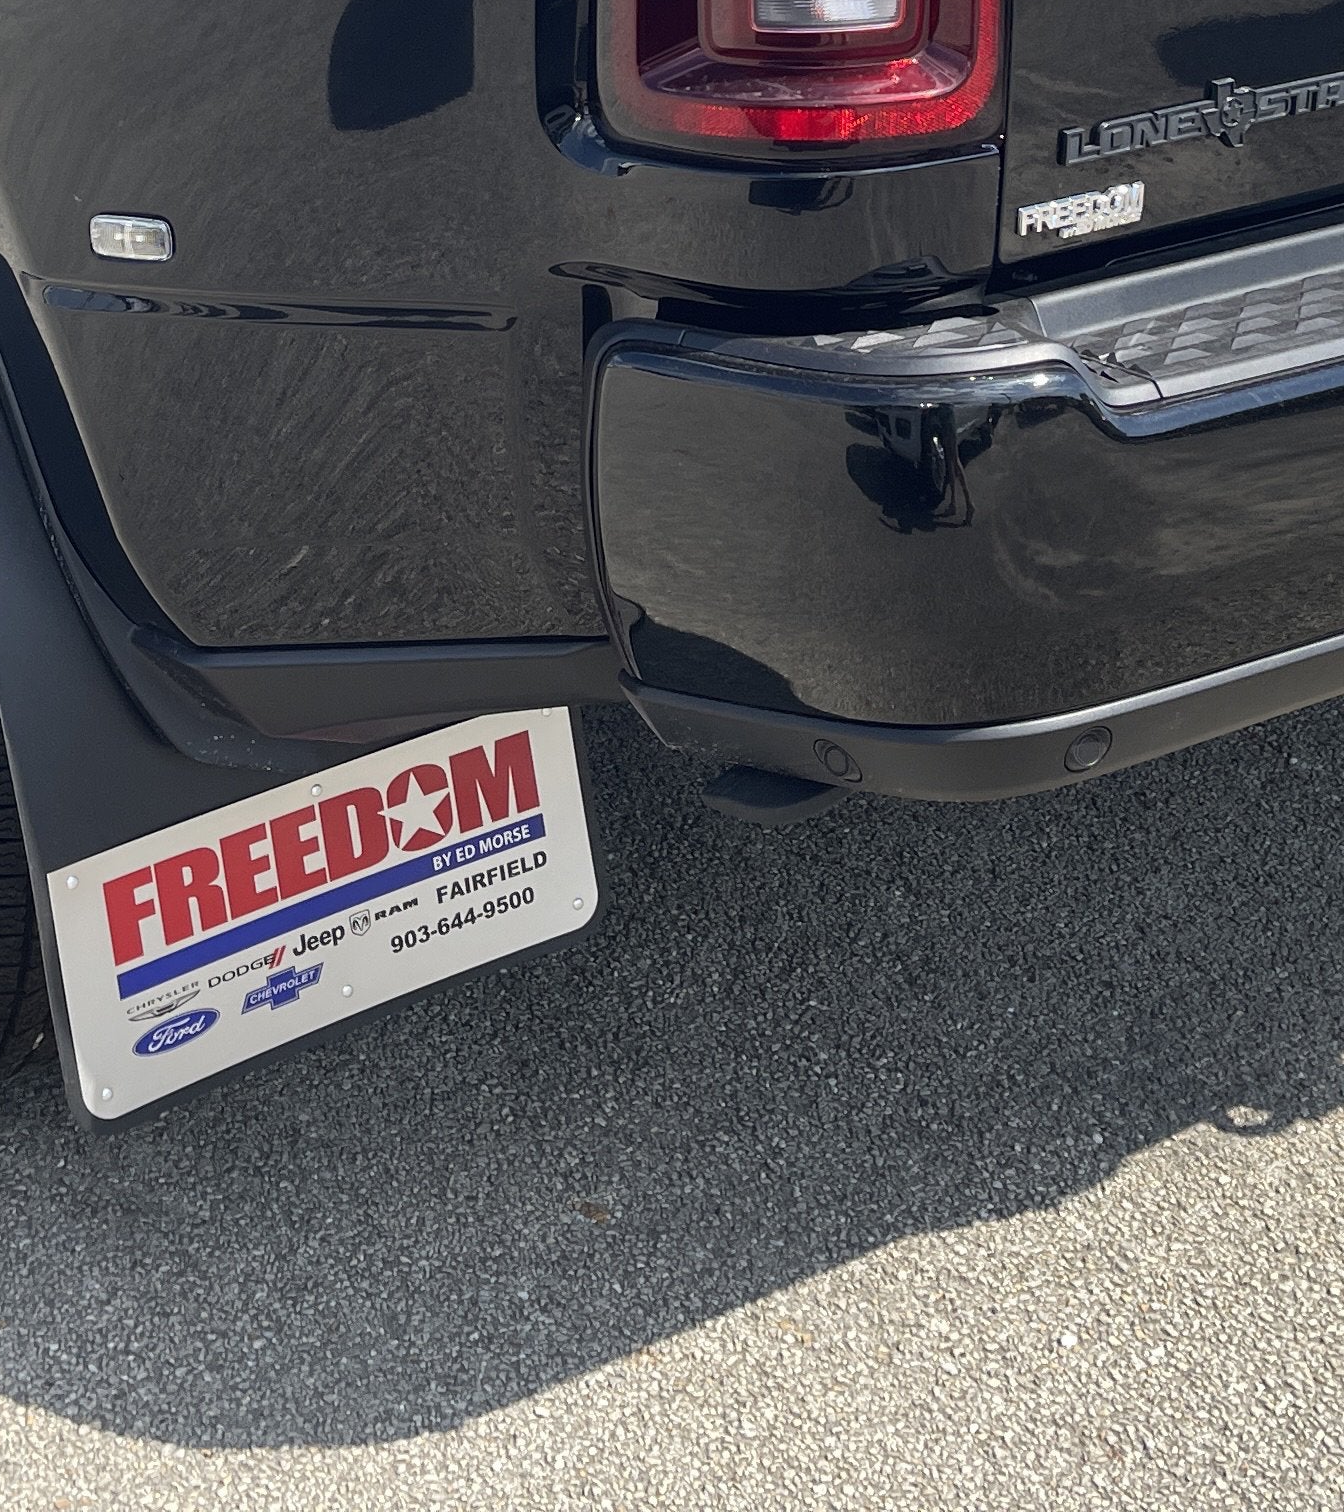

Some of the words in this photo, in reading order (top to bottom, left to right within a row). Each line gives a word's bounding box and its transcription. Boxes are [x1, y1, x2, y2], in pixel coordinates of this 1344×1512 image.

[1061, 99, 1213, 166] LONE
[1017, 180, 1145, 237] FREEDOM
[103, 730, 541, 966] FREEDOM
[432, 851, 452, 872] BY
[456, 844, 476, 864] ED
[478, 824, 531, 855] MORSE
[436, 850, 548, 905] FAIRFIELD
[390, 886, 536, 954] 903-644-9500
[126, 981, 200, 1015] CHRYSLER
[208, 953, 275, 988] DODGE
[292, 924, 346, 957] Jeep
[374, 897, 419, 921] RAM
[249, 970, 317, 1006] CHEVROLET
[147, 1014, 206, 1053] Ford
